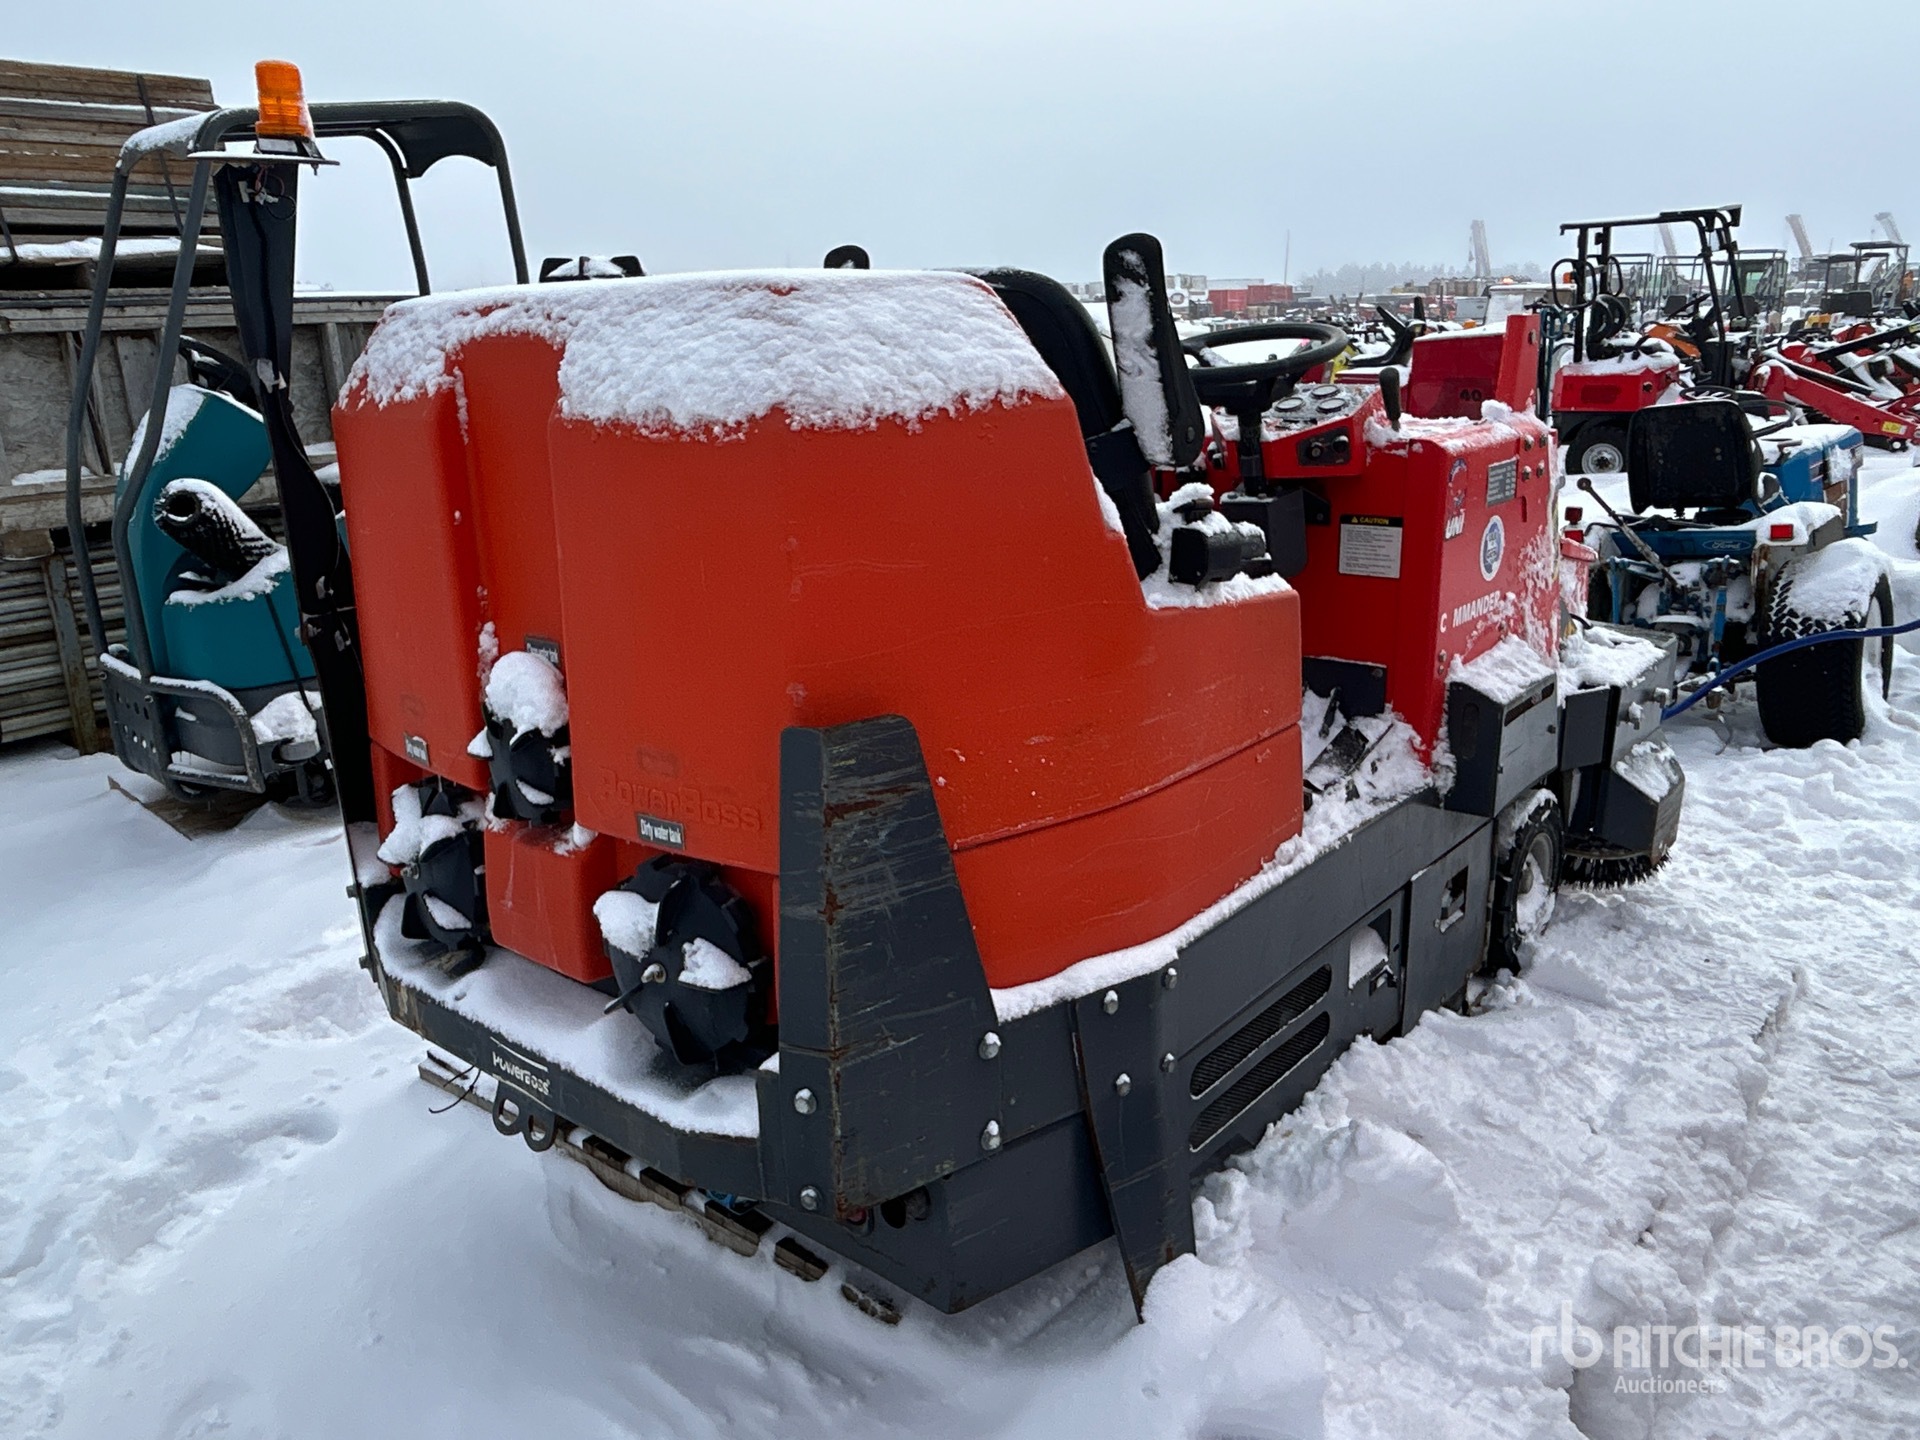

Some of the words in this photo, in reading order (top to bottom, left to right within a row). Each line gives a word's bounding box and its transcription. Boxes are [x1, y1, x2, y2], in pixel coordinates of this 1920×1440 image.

[1359, 516, 1389, 525] CAUTION
[1711, 540, 1741, 550] Ford
[640, 818, 653, 841] Dirty
[654, 824, 668, 840] water
[669, 826, 682, 844] tank
